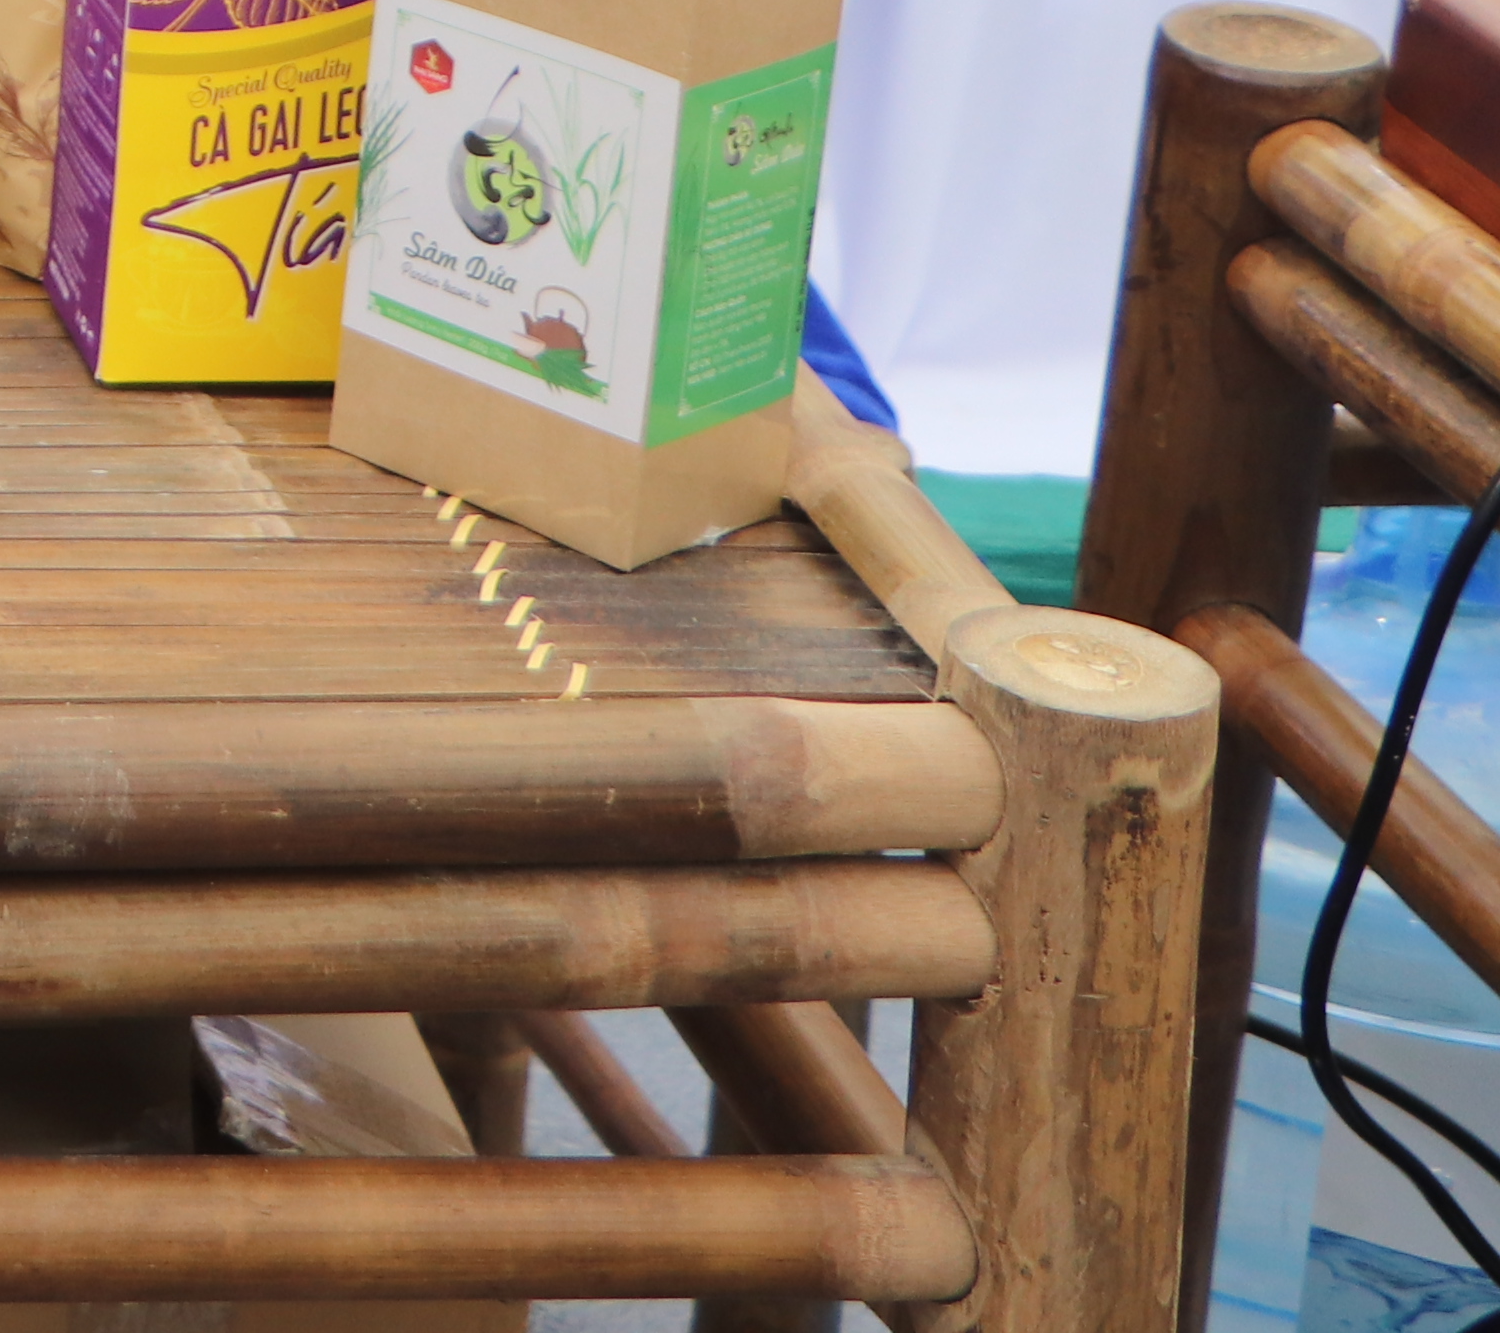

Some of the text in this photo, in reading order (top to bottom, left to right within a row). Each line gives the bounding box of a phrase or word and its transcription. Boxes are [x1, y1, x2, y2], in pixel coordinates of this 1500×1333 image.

[188, 57, 353, 110] Special Quality
[190, 96, 303, 168] CÀ GAI
[402, 231, 460, 274] Sâm
